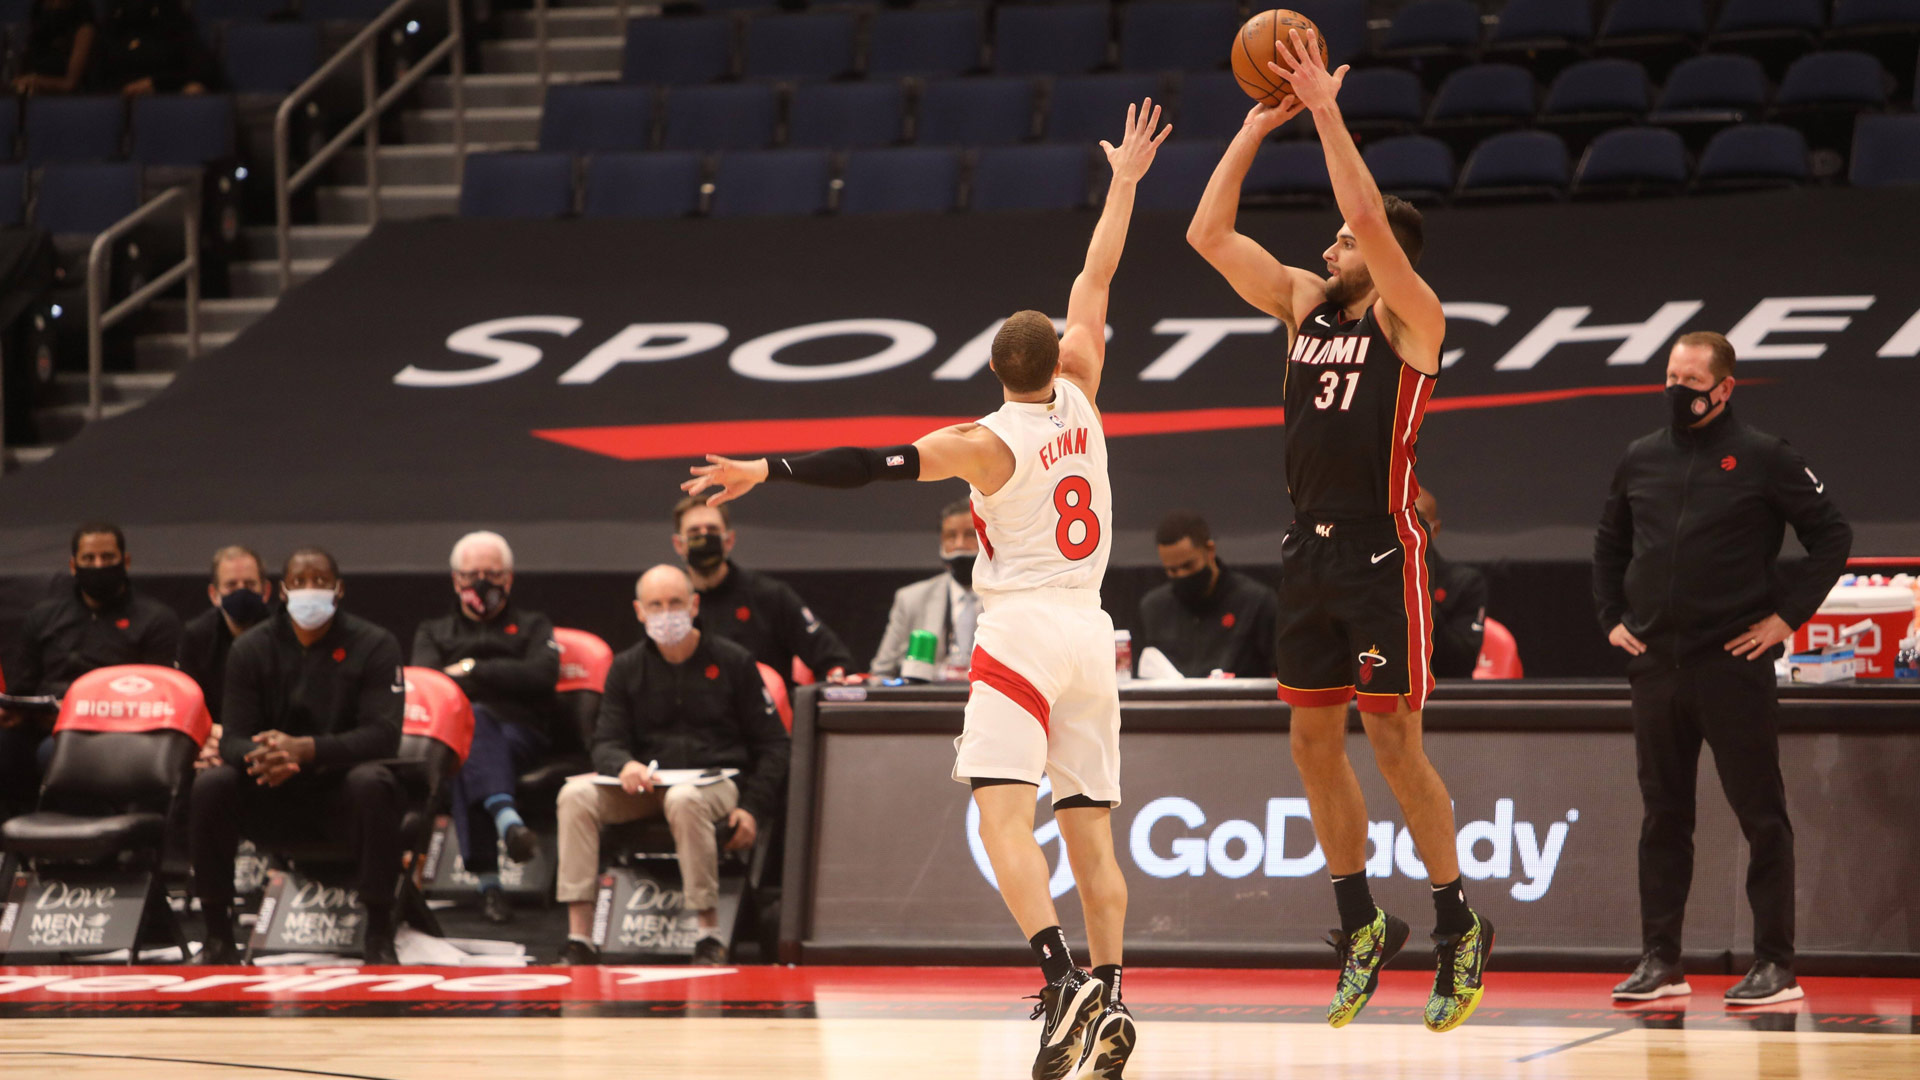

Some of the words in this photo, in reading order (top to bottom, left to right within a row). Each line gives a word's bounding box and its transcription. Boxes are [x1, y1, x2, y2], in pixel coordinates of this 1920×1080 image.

[1314, 370, 1361, 411] 31
[1039, 427, 1088, 471] FLYNN
[1053, 475, 1101, 561] 8
[1807, 623, 1882, 655] BO
[75, 699, 175, 717] BIOSTEEL
[35, 881, 117, 910] Dove
[31, 912, 85, 931] MEN
[285, 911, 337, 930] MEN
[621, 914, 677, 931] MEN
[27, 927, 106, 946] +CARE
